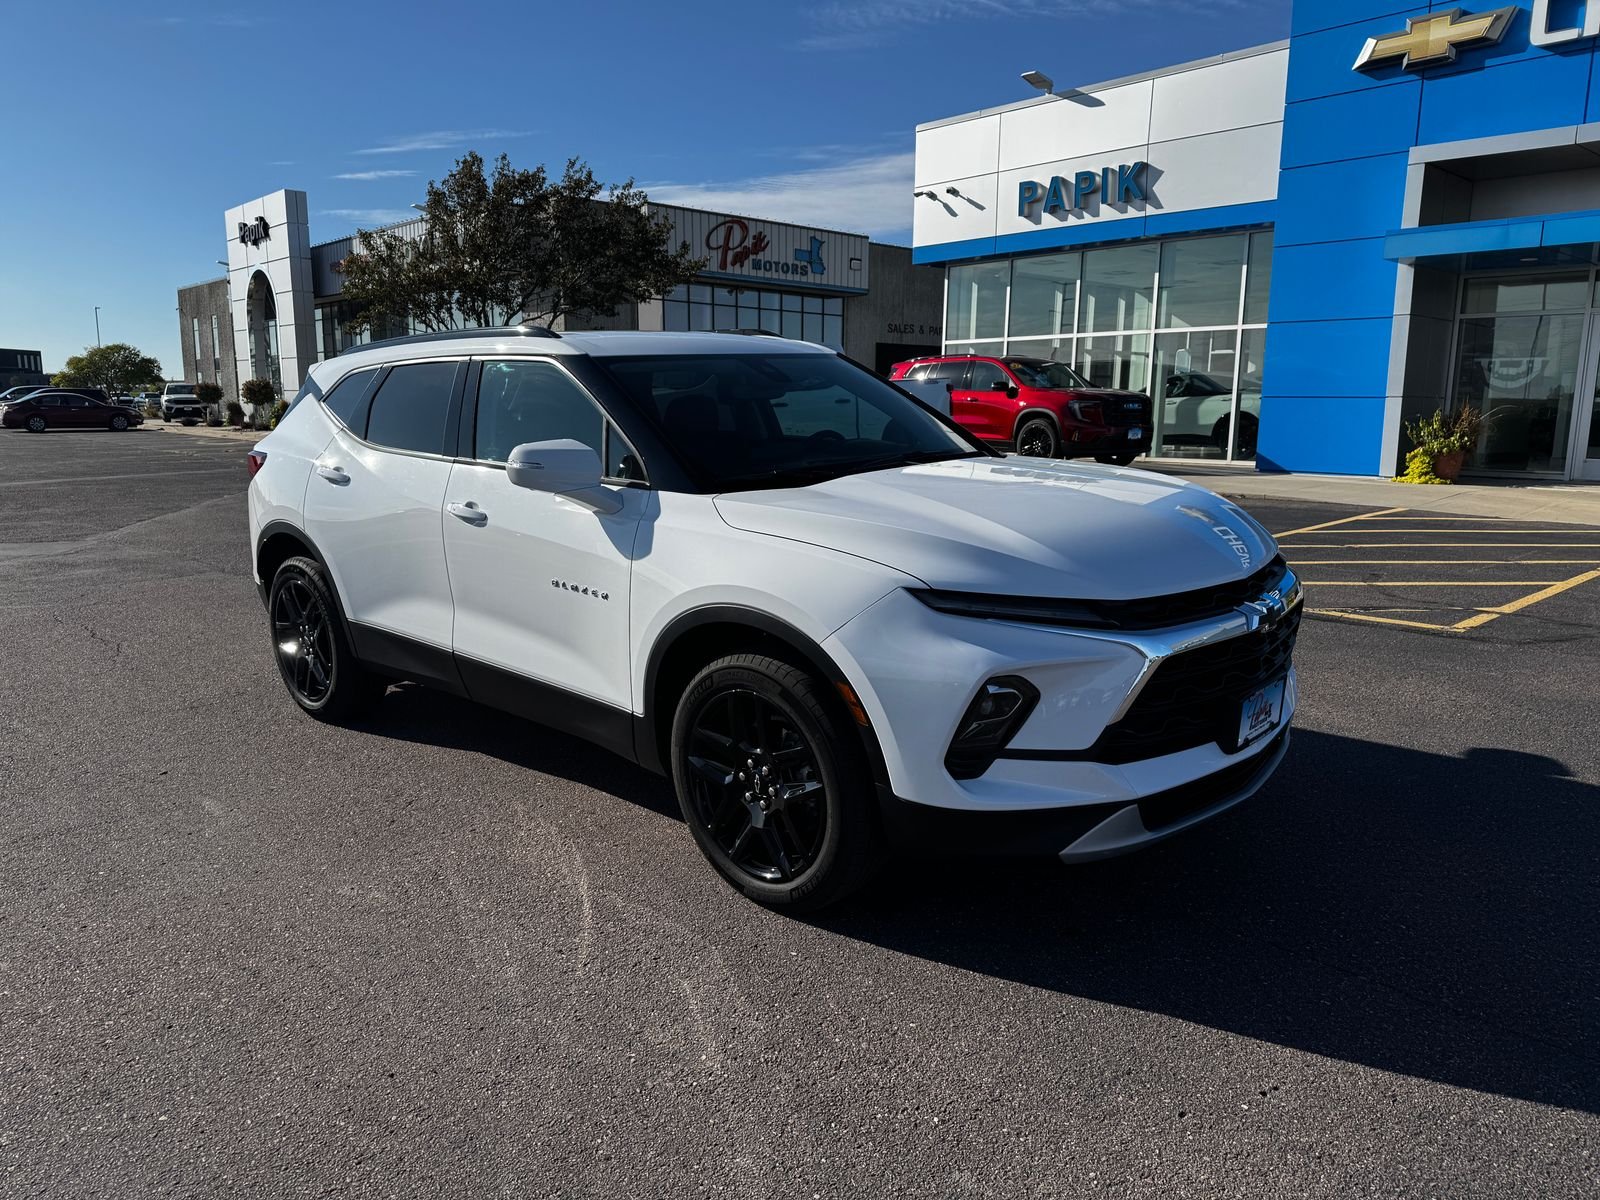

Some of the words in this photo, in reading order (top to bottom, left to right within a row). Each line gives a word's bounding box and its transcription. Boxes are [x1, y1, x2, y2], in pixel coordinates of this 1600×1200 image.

[1018, 161, 1147, 217] PAPIK
[238, 216, 267, 247] Papik
[705, 219, 770, 271] Papik
[752, 258, 809, 276] MOTORS
[887, 323, 914, 334] SALES
[919, 324, 924, 335] &
